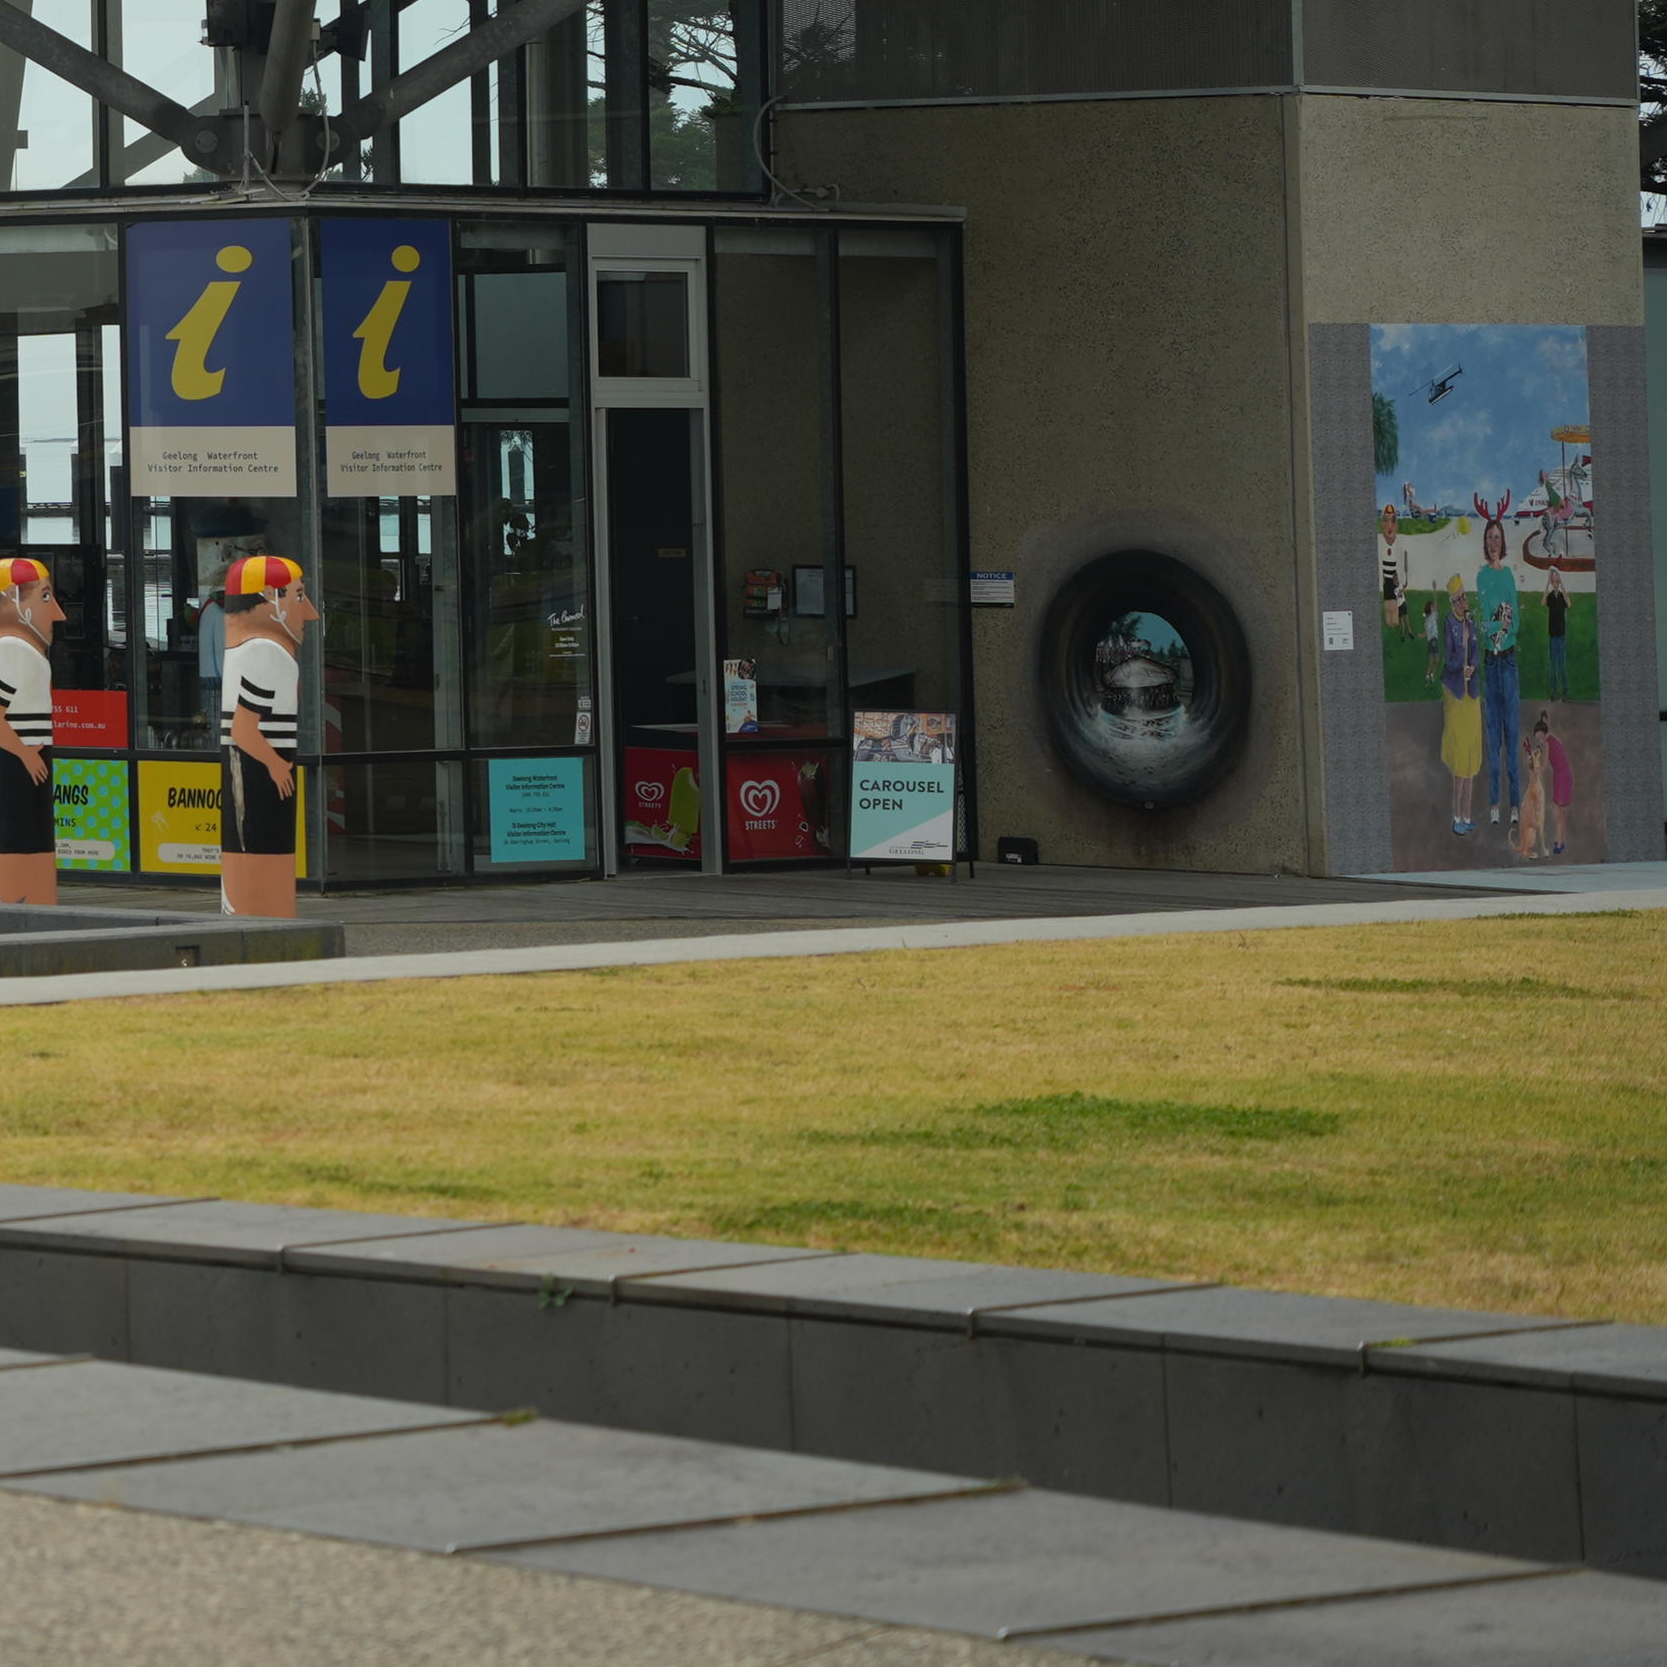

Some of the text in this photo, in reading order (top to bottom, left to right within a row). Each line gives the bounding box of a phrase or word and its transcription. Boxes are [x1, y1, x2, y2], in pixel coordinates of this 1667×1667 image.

[162, 451, 258, 462] Geelong Waterfront
[351, 450, 427, 461] Geelong Waterfront
[147, 464, 279, 473] Visitor Information Centre
[340, 464, 443, 472] Visitor Information Centre
[53, 720, 107, 729] larine.com.au
[859, 779, 945, 793] CAROUSEL
[53, 784, 89, 806] ANGS
[167, 787, 222, 810] BANNOC
[638, 801, 662, 809] STREETS
[859, 797, 904, 811] OPEN
[205, 822, 217, 833] 24
[745, 819, 776, 830] STREETS
